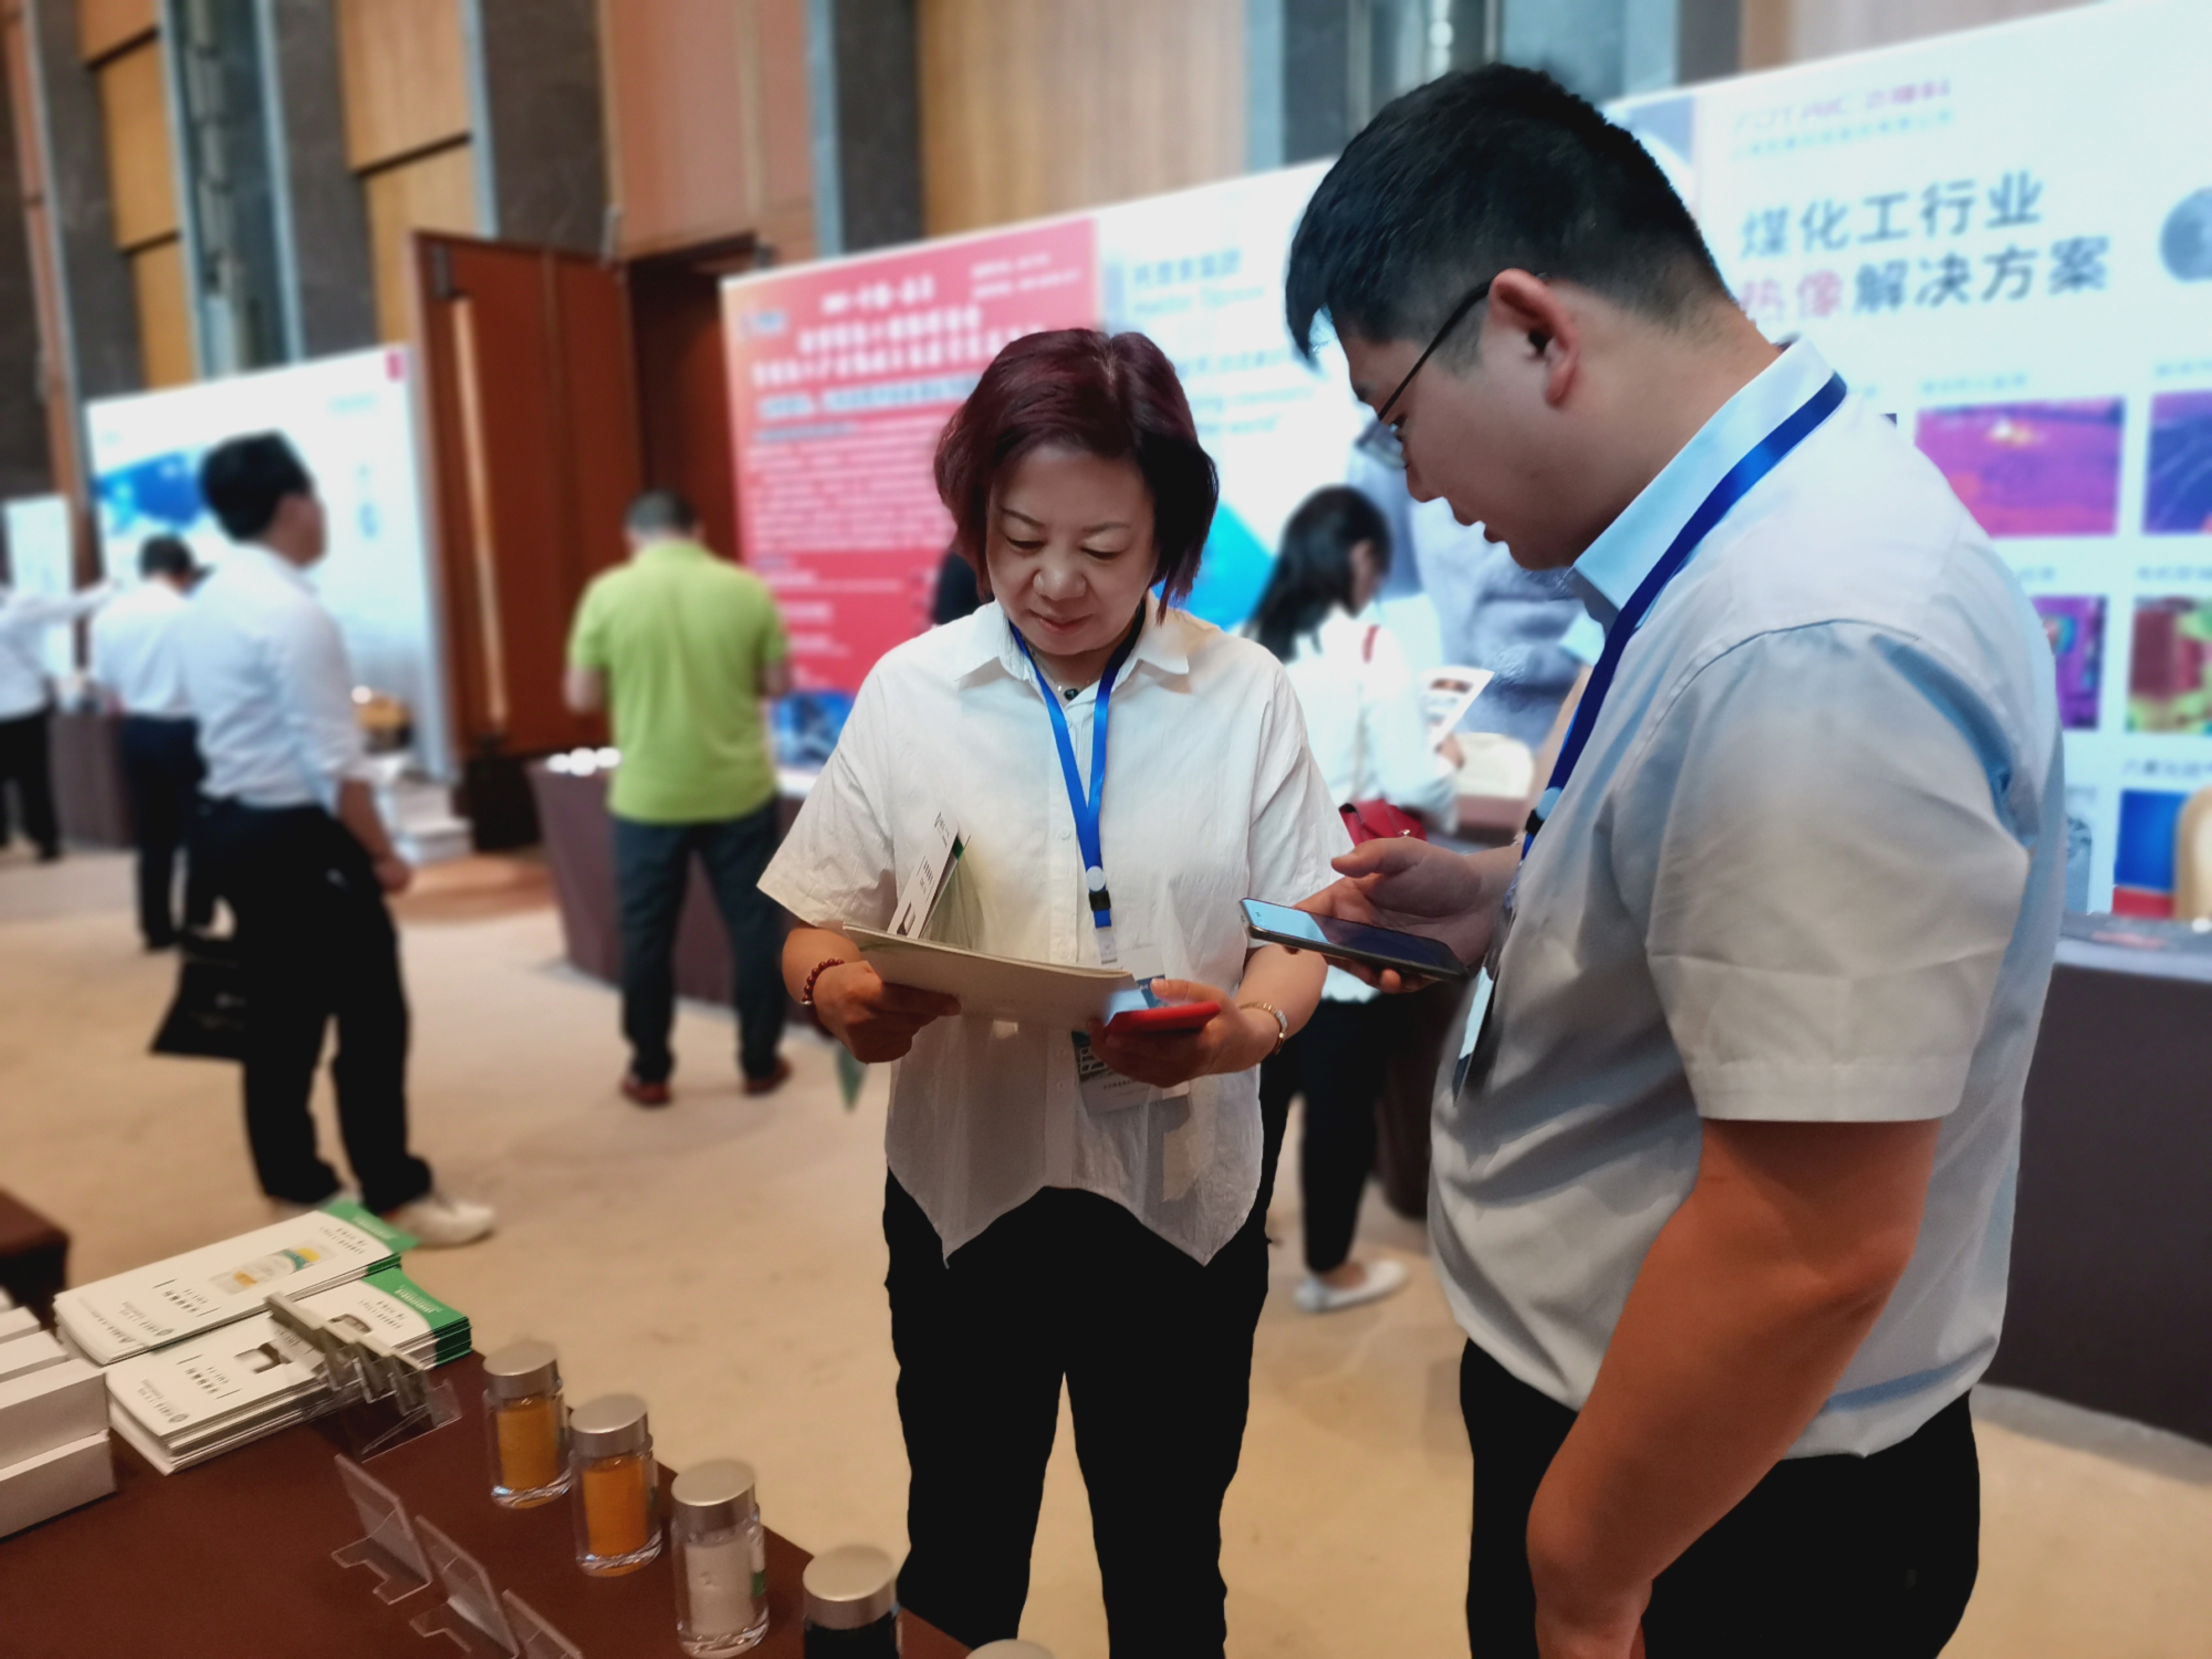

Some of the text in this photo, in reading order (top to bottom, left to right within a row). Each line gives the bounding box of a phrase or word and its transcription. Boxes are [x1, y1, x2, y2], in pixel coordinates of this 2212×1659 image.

[1743, 170, 2042, 257] 煤化工行业
[1741, 236, 2109, 320] 热像解决方案
